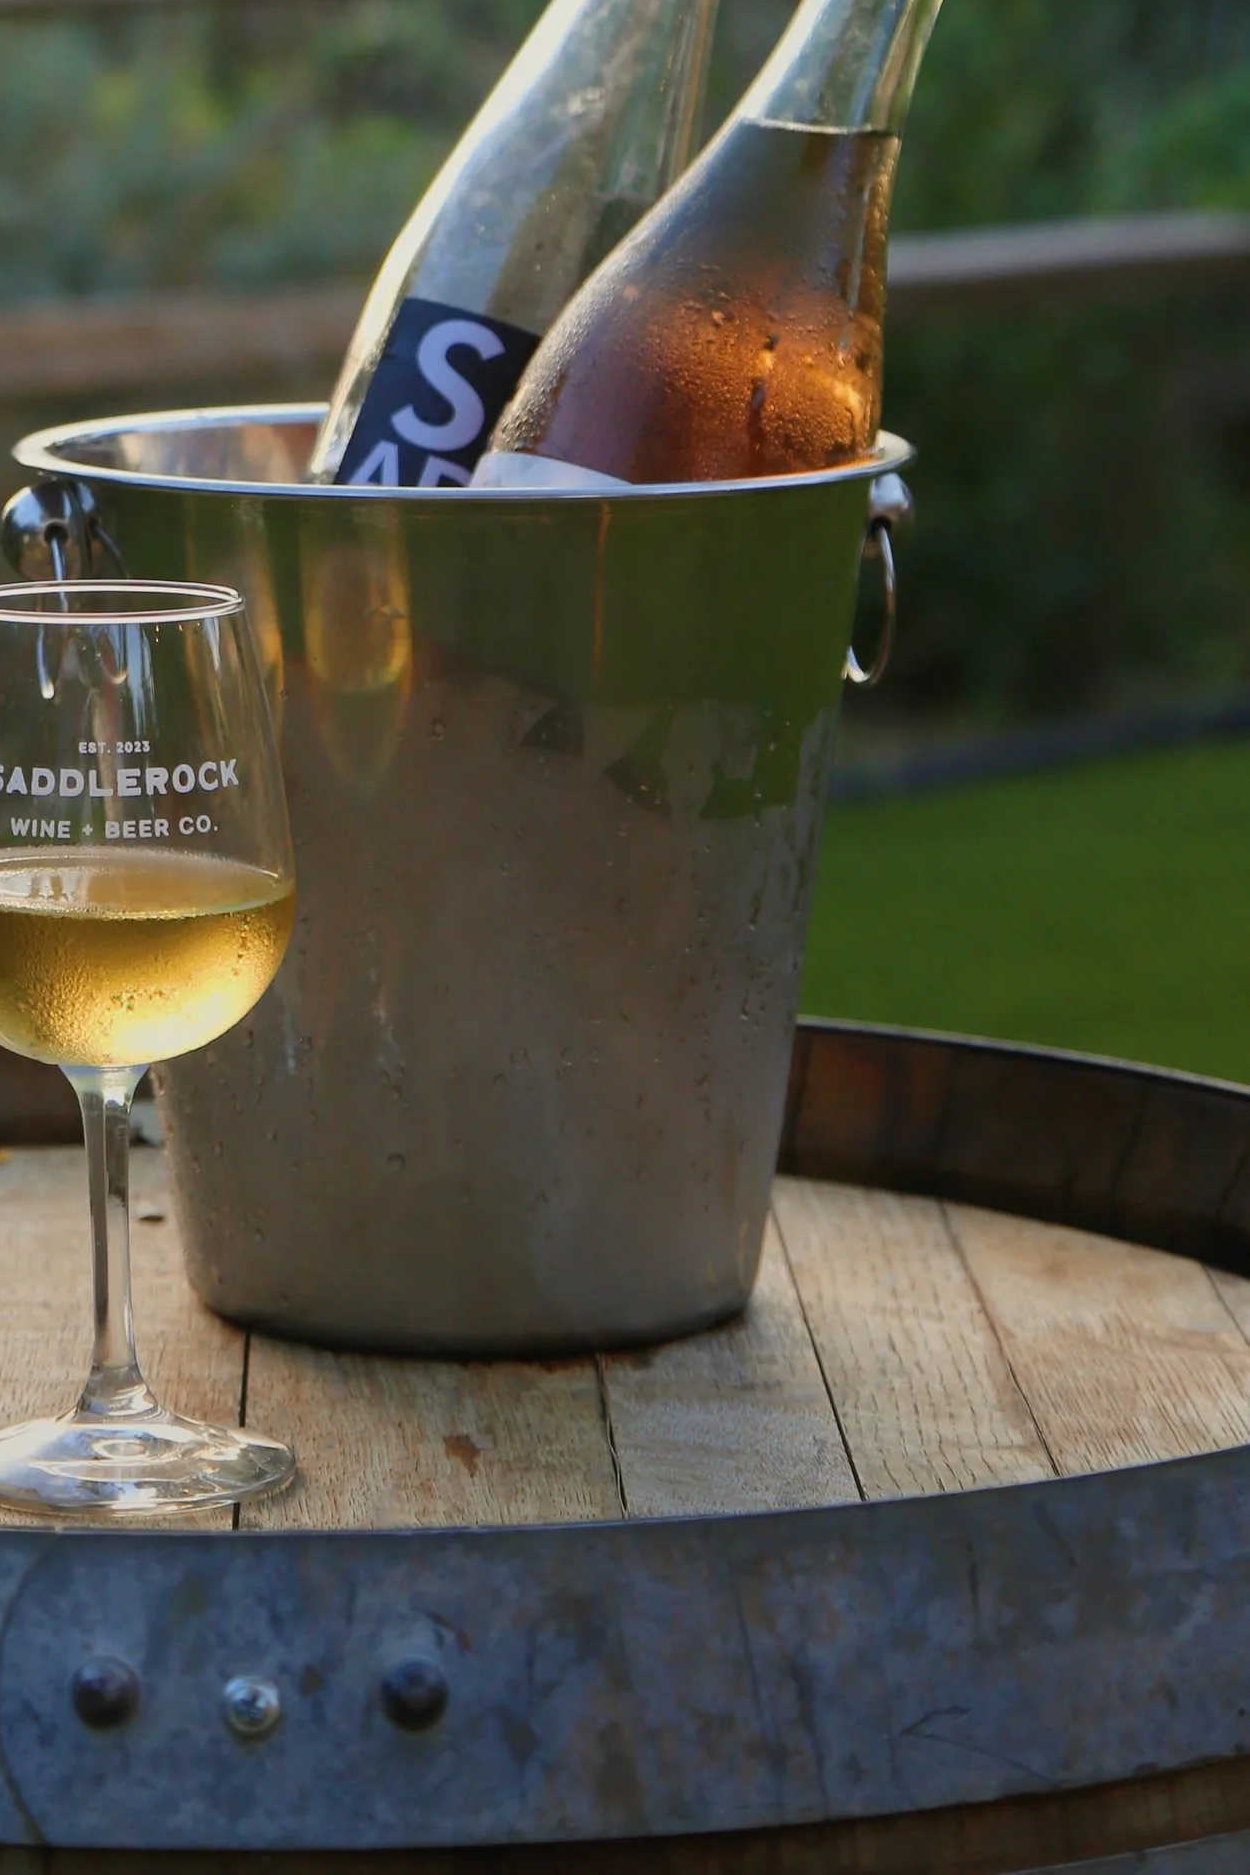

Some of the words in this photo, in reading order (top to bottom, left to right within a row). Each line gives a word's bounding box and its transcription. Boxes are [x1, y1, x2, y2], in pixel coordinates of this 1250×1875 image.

[391, 319, 506, 452] S
[78, 741, 111, 754] EST.
[116, 740, 151, 754] 2023
[10, 817, 72, 839] WINE
[104, 818, 170, 839] BEER
[178, 814, 219, 835] CO.
